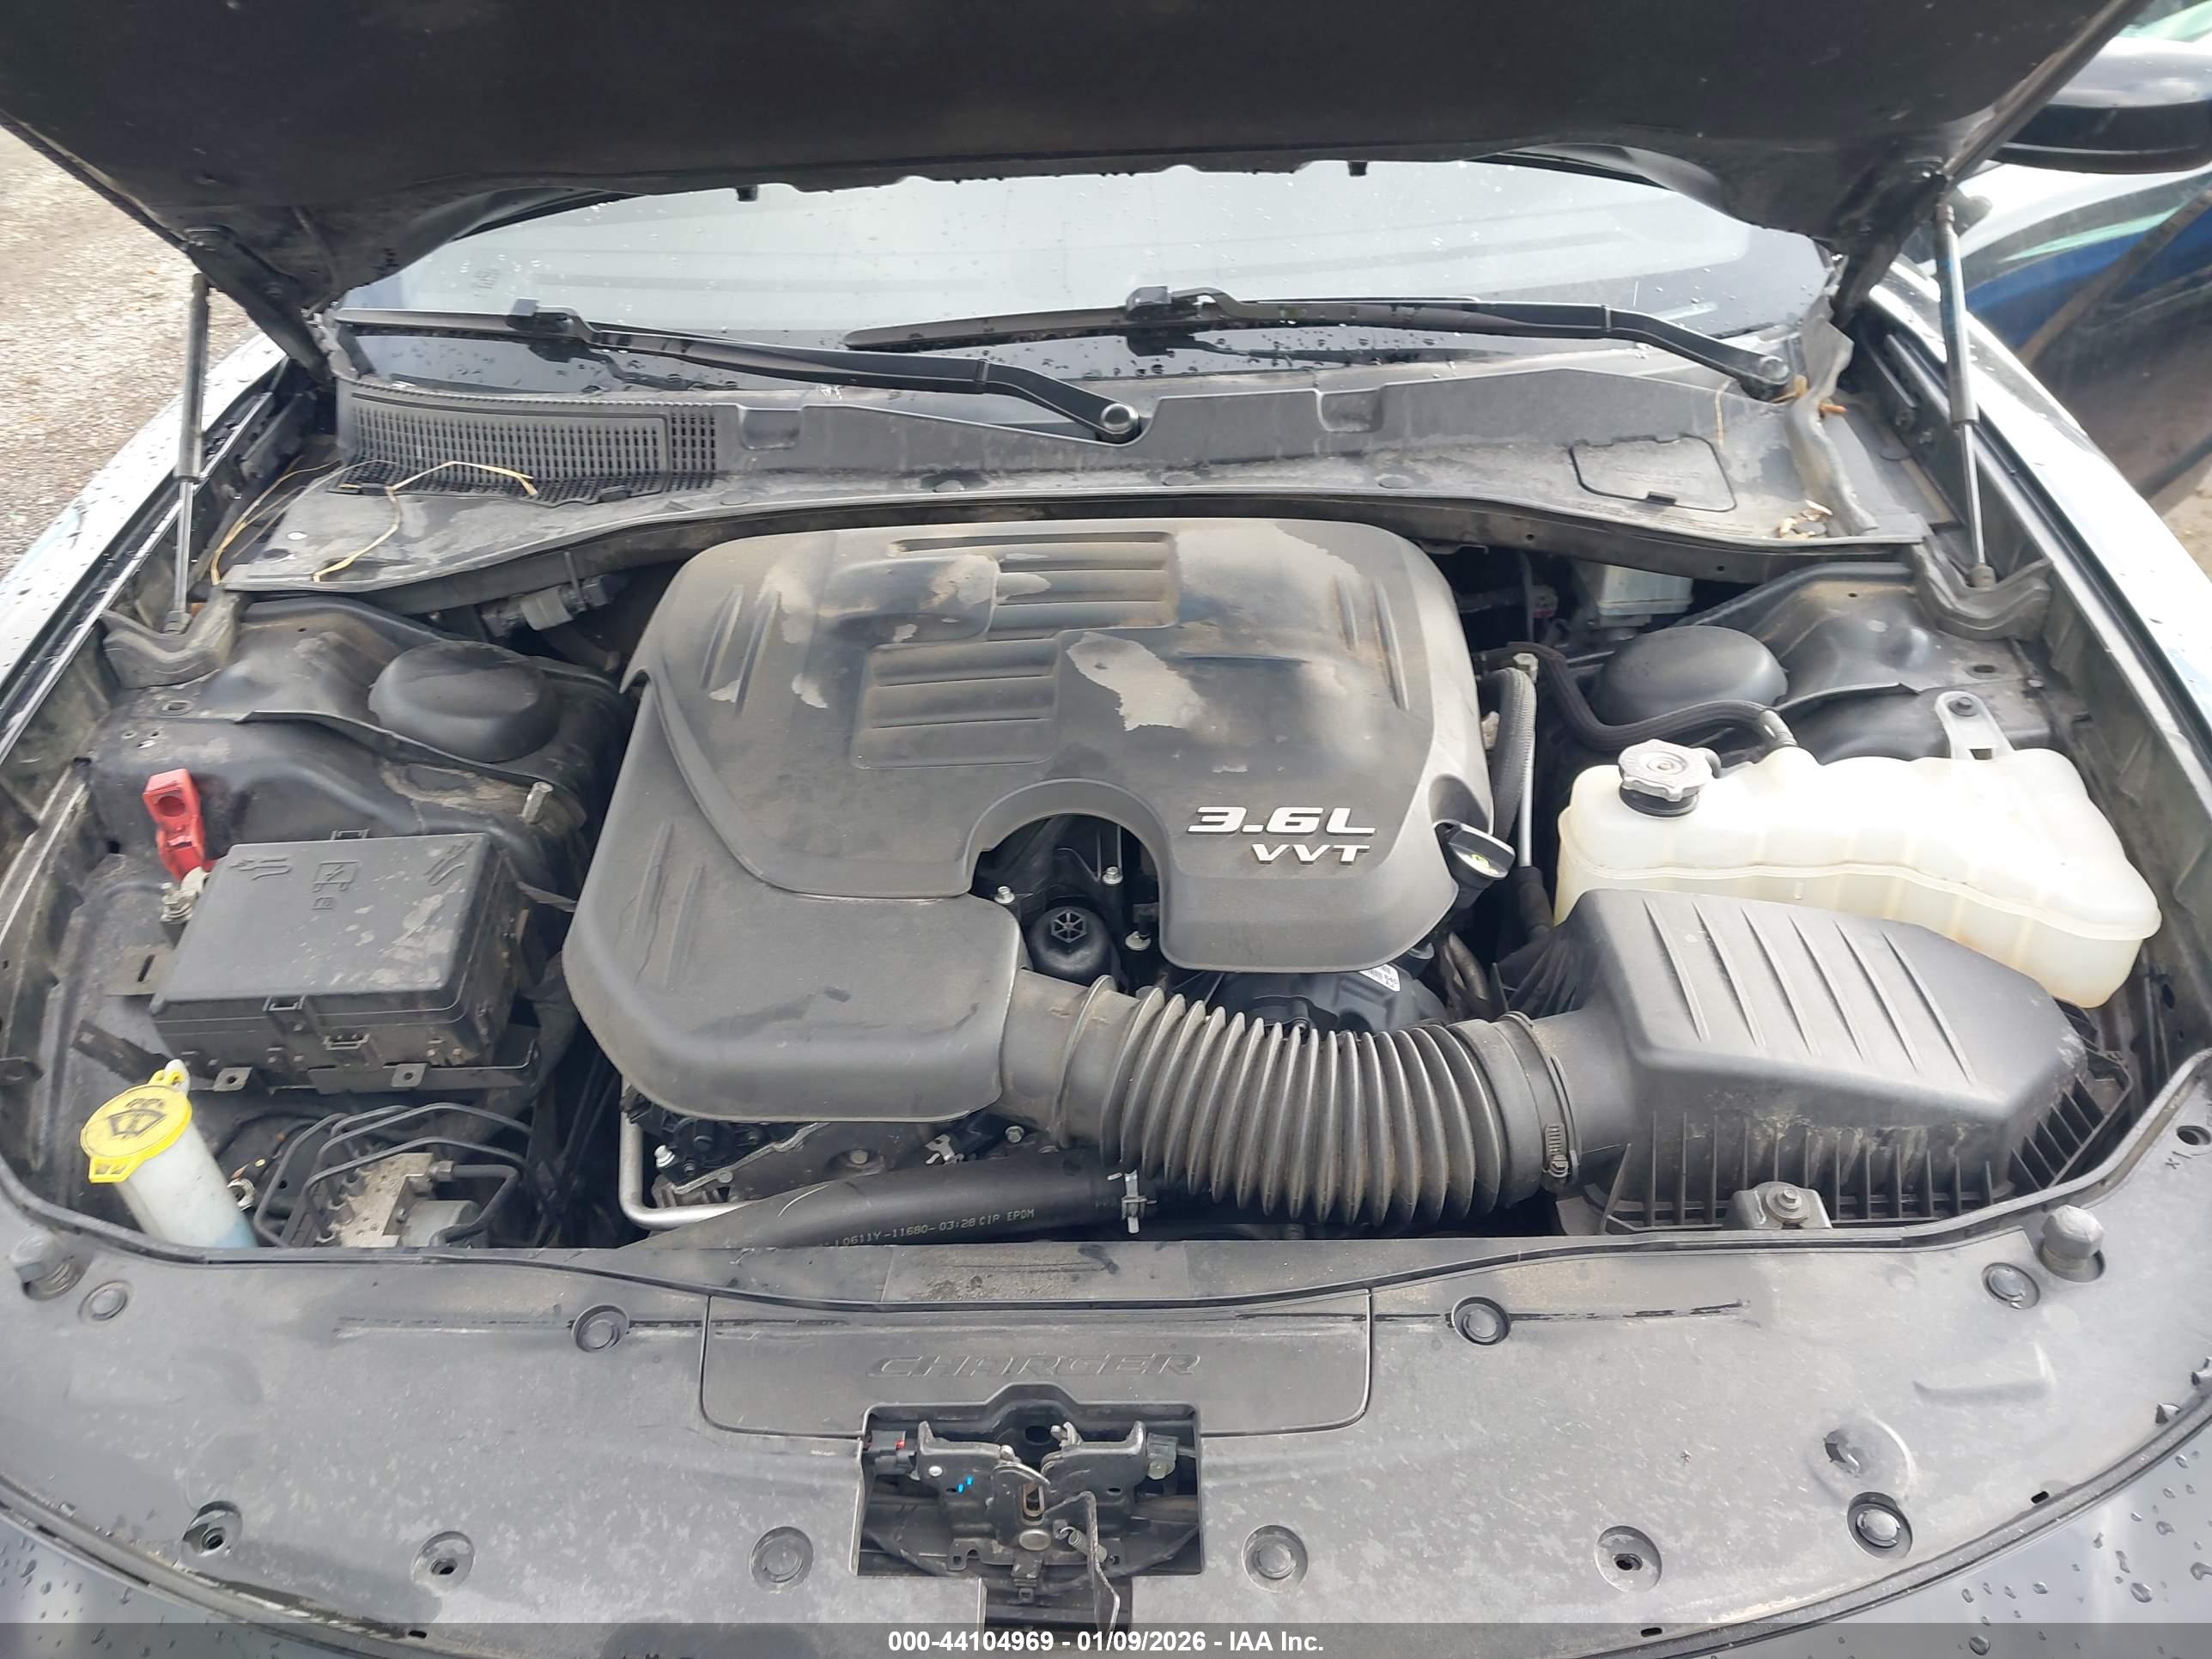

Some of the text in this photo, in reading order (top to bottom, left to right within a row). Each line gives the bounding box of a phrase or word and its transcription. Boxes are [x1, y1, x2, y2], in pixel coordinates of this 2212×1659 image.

[1187, 806, 1376, 836] 3.6L
[1251, 843, 1371, 865] VVT
[1006, 1208, 1036, 1222] EPDM
[866, 1352, 1201, 1377] CHARGER
